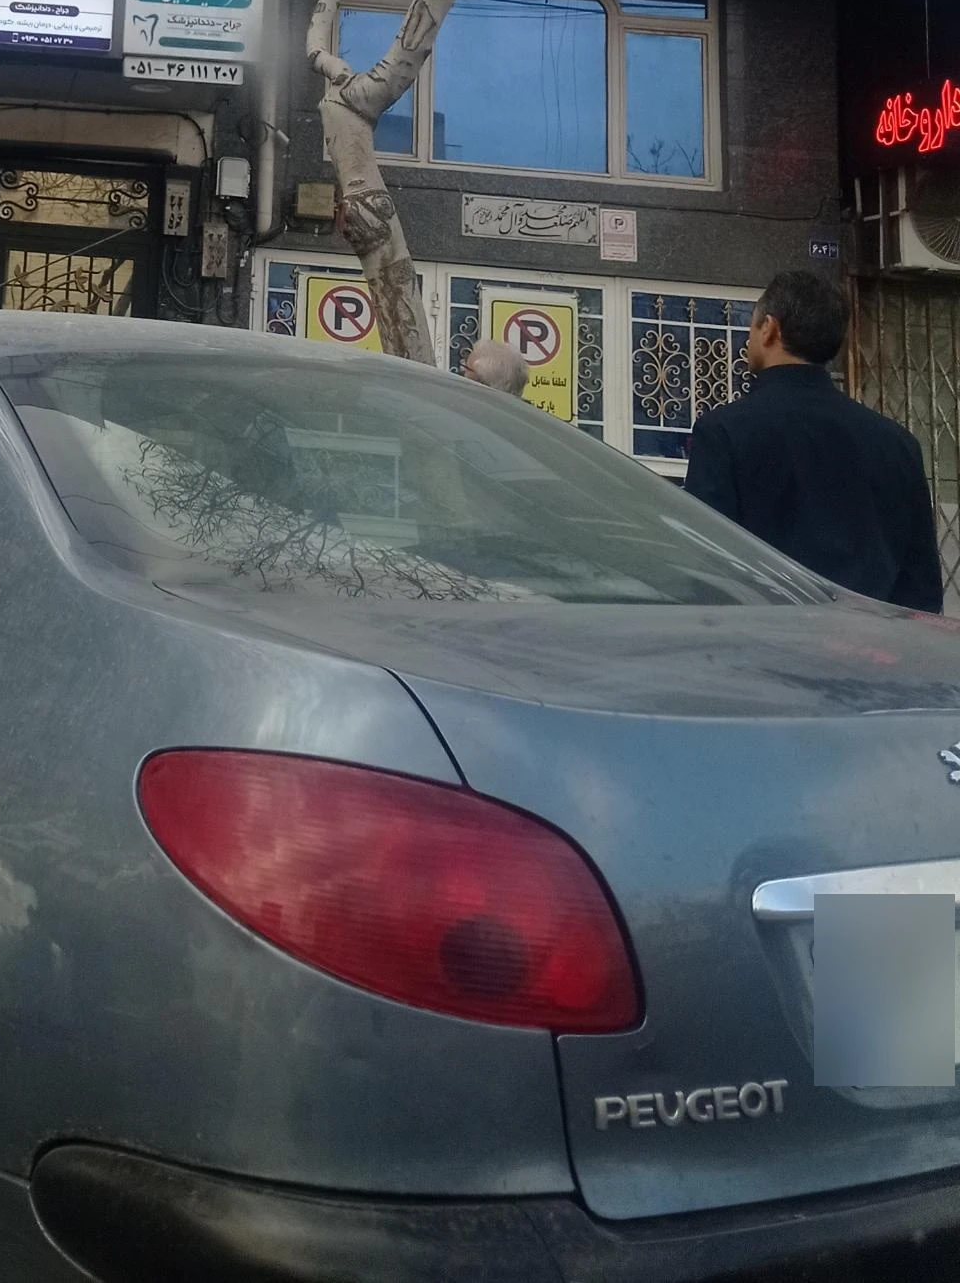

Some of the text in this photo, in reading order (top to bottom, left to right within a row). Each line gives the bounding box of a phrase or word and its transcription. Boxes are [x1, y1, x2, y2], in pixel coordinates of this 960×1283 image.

[191, 64, 208, 78] ۱۱۱
[214, 66, 238, 81] ۲۰۷
[593, 1079, 789, 1131] PEUGEOT
